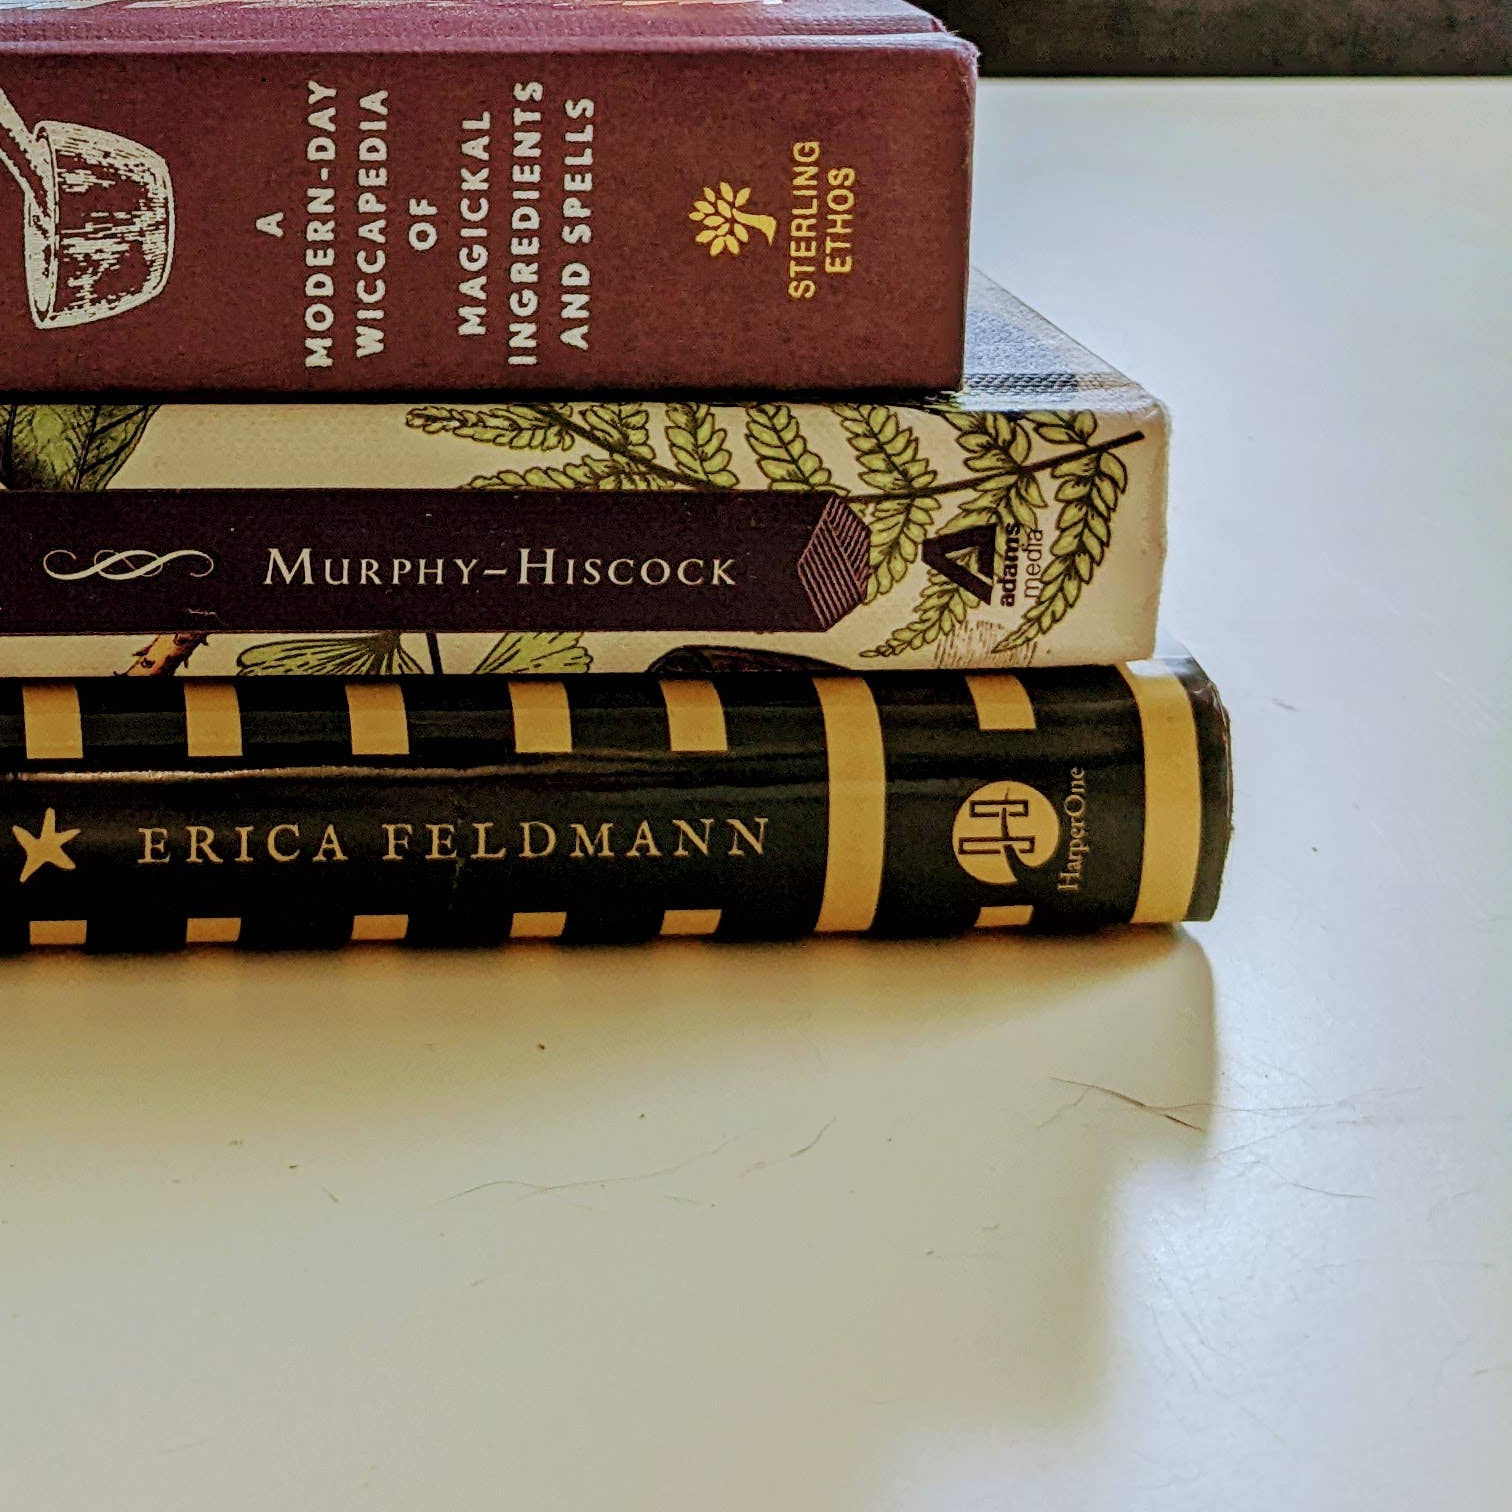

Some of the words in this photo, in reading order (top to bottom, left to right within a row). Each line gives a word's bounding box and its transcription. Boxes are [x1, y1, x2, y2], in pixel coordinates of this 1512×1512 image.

[255, 212, 284, 238] A
[304, 80, 337, 368] MODERN-DAY
[355, 90, 389, 358] WICCAPEDIA
[408, 198, 438, 251] OF
[457, 111, 491, 336] MAGICKAL
[507, 81, 544, 365] INGREDIENTS
[561, 98, 595, 244] SPELLS
[788, 141, 821, 299] STERLING
[824, 167, 856, 274] ETHOS
[559, 262, 591, 350] AND
[997, 522, 1021, 607] adams
[1023, 527, 1044, 598] media
[137, 823, 351, 865] ERICA
[381, 817, 772, 861] FELDMANN
[1056, 766, 1090, 891] HarperOne
